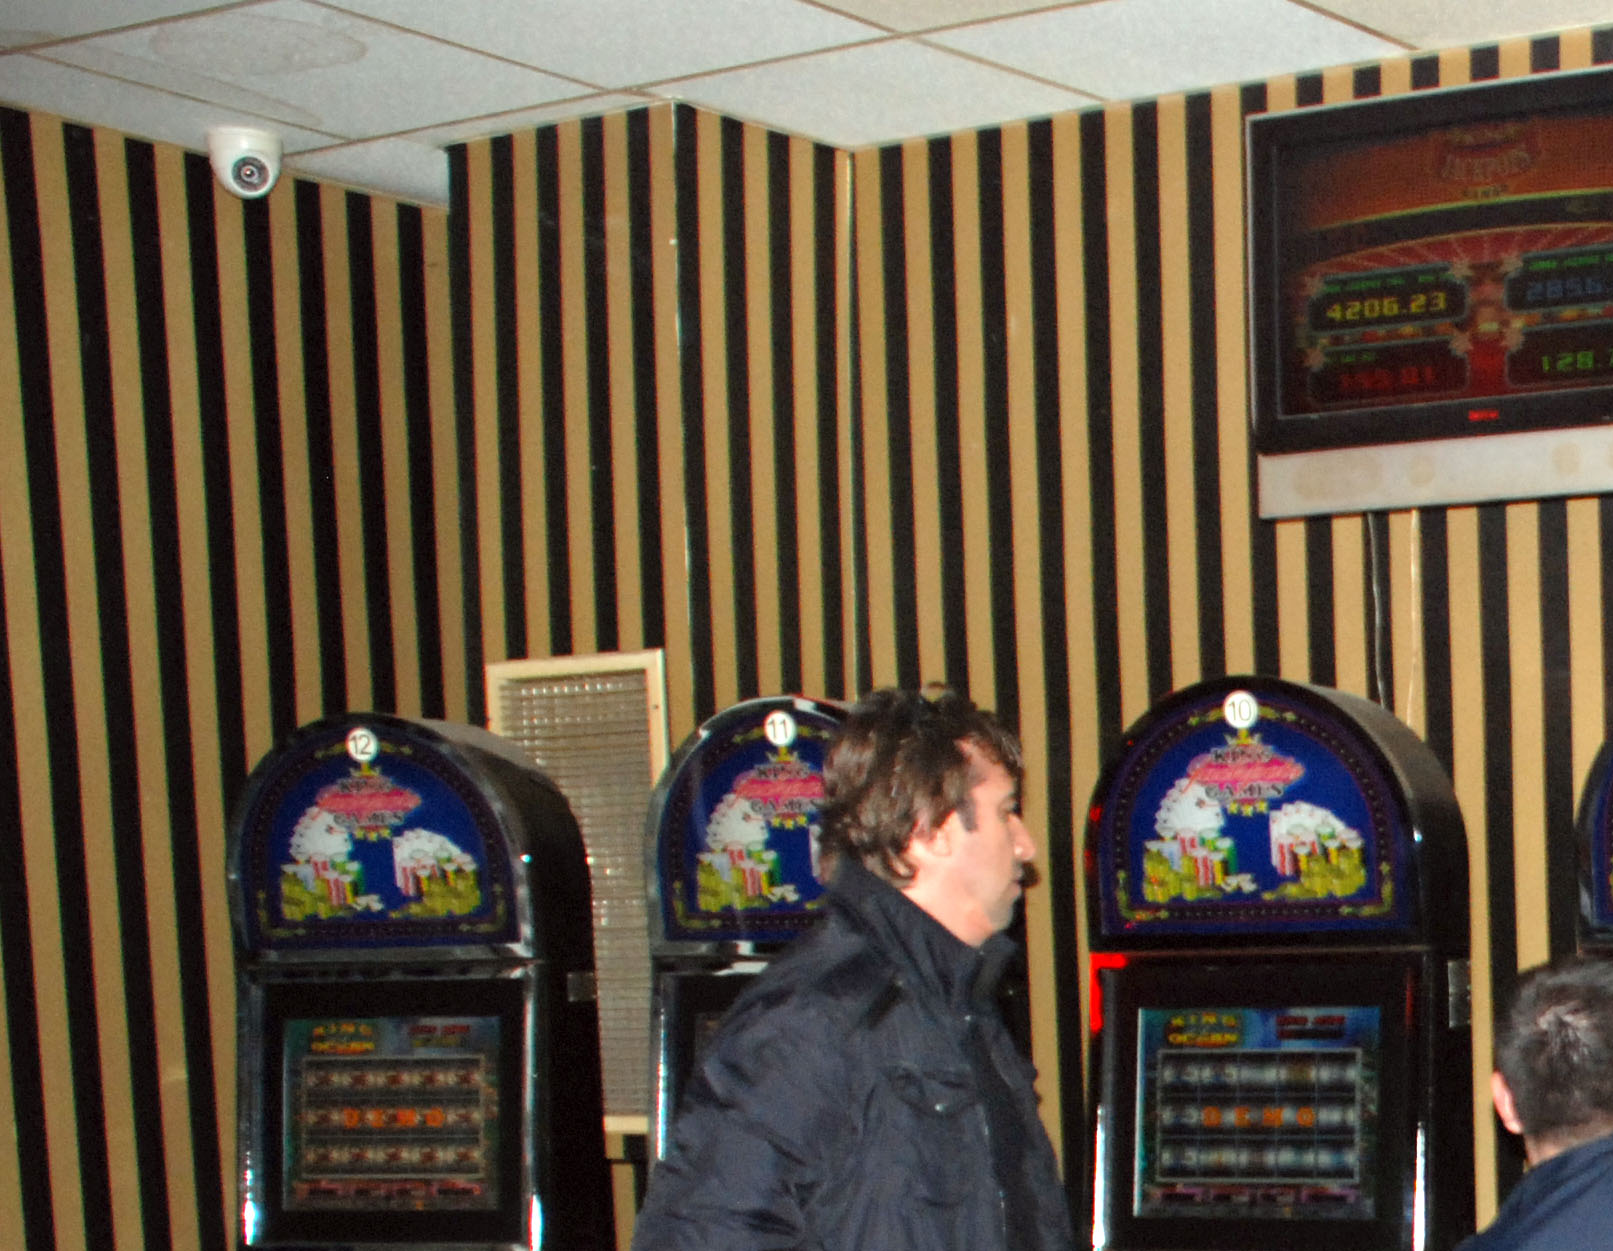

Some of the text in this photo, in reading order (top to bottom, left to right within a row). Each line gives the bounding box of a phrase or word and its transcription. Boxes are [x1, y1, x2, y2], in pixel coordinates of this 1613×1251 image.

[1326, 292, 1447, 322] 4206.23
[1228, 698, 1252, 722] 10
[767, 717, 788, 740] 11
[349, 733, 372, 755] 12
